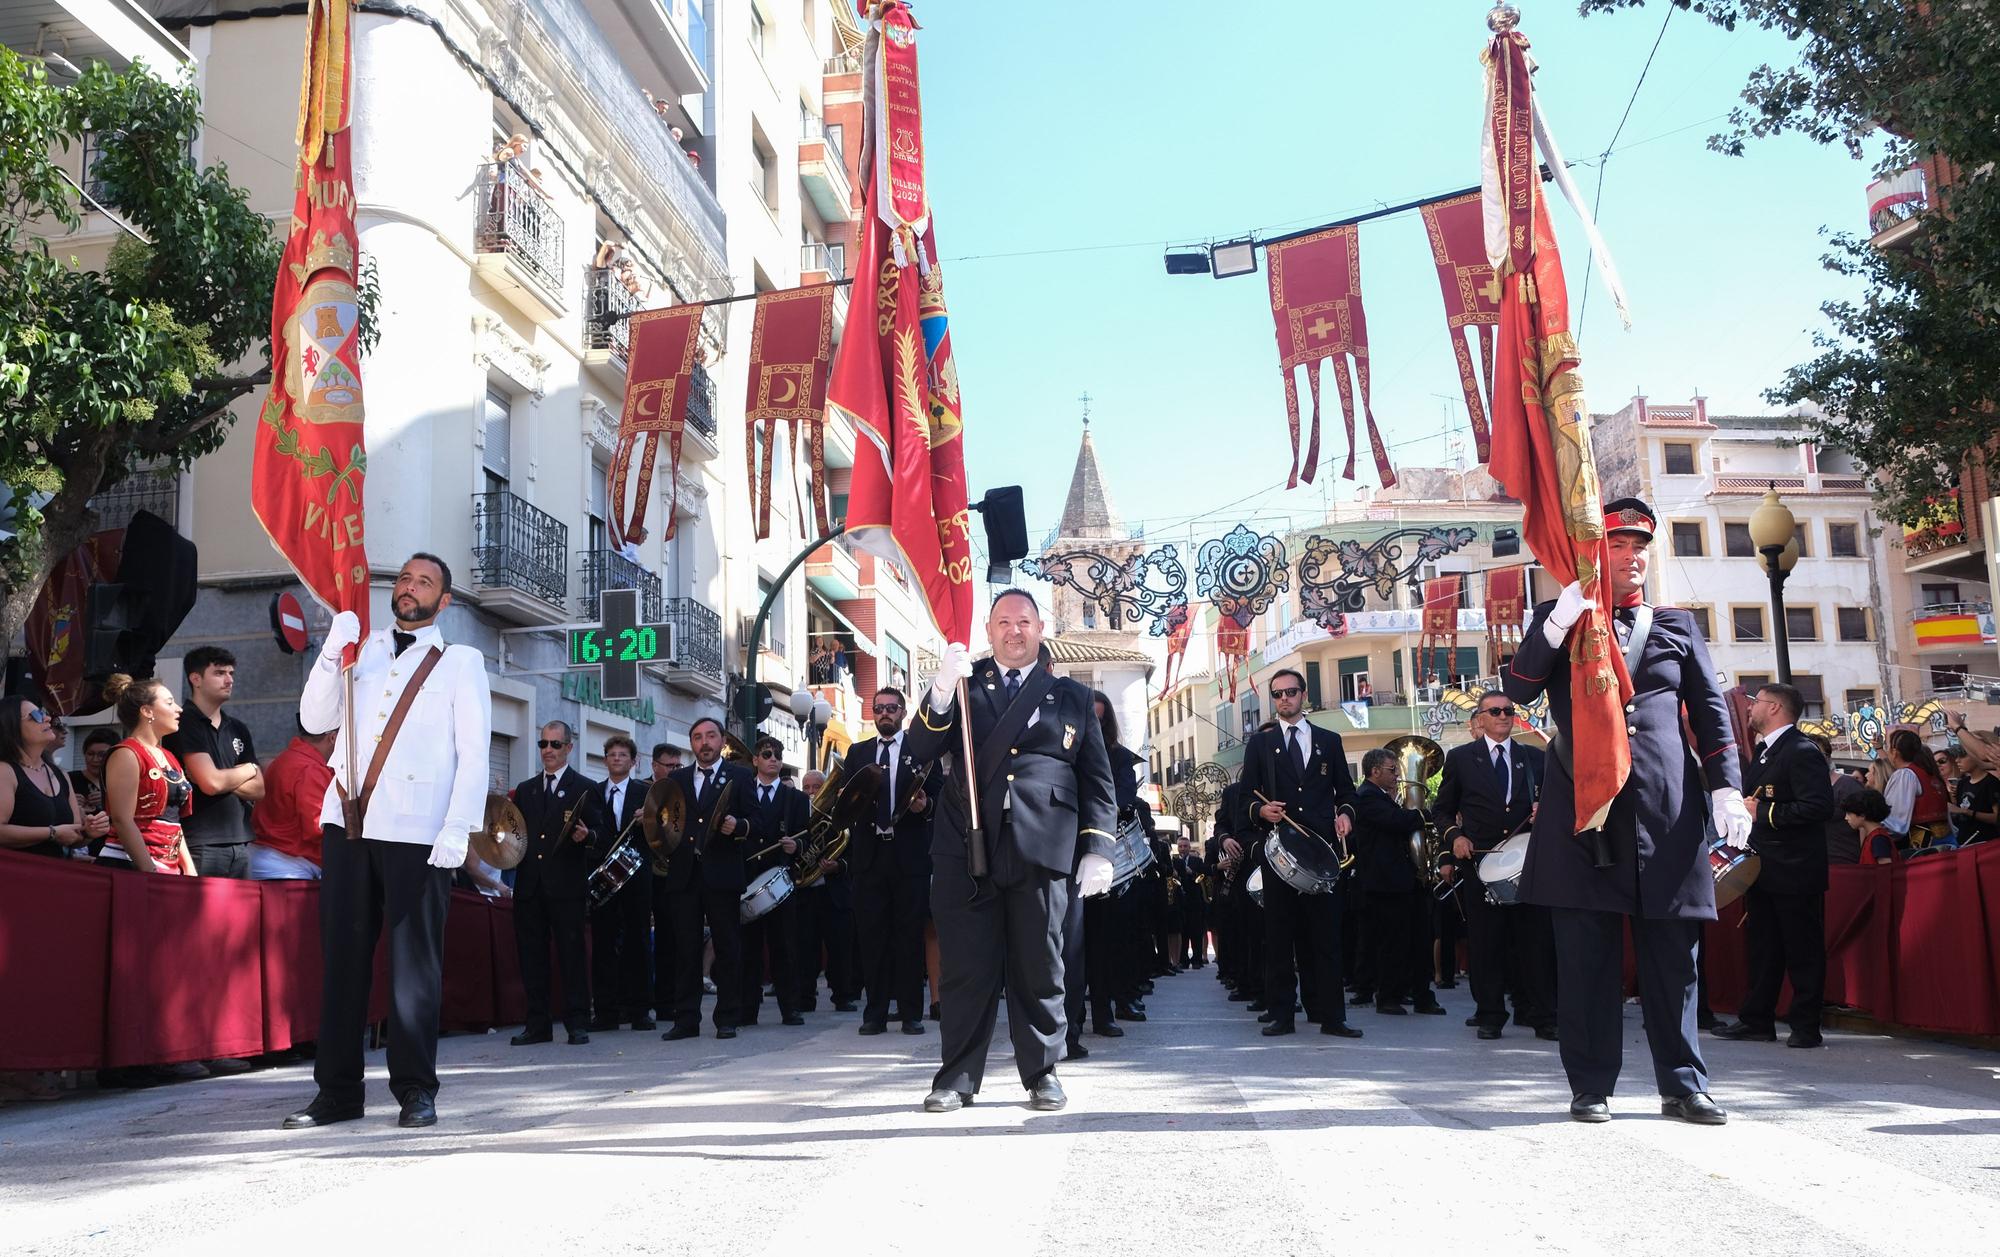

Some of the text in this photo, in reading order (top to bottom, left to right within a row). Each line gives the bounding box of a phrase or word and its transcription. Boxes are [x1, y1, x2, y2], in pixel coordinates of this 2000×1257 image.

[891, 177, 922, 192] VILLENA
[897, 190, 918, 202] 2022
[572, 626, 657, 664] 16:20
